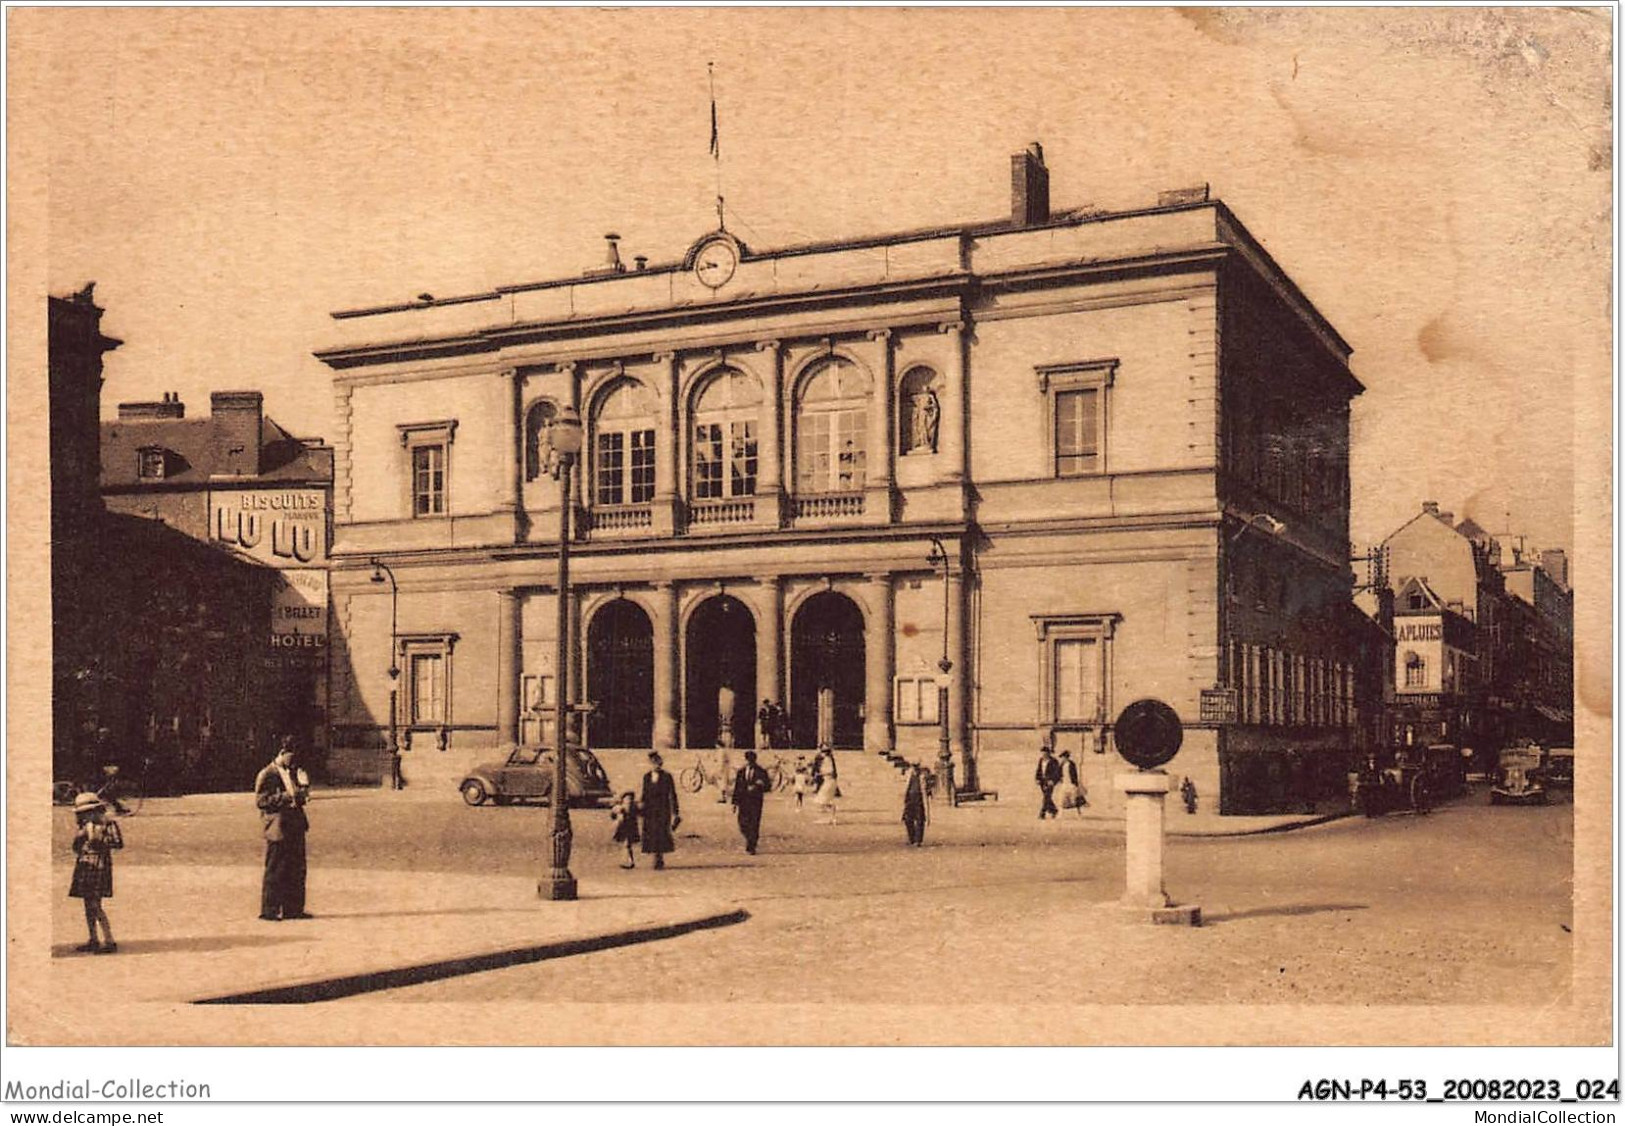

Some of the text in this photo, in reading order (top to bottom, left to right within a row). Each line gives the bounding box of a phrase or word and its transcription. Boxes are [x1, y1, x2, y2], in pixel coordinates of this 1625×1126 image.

[241, 494, 319, 510] BISCUITS
[217, 505, 318, 563] LU LU
[271, 634, 325, 647] HOTEL
